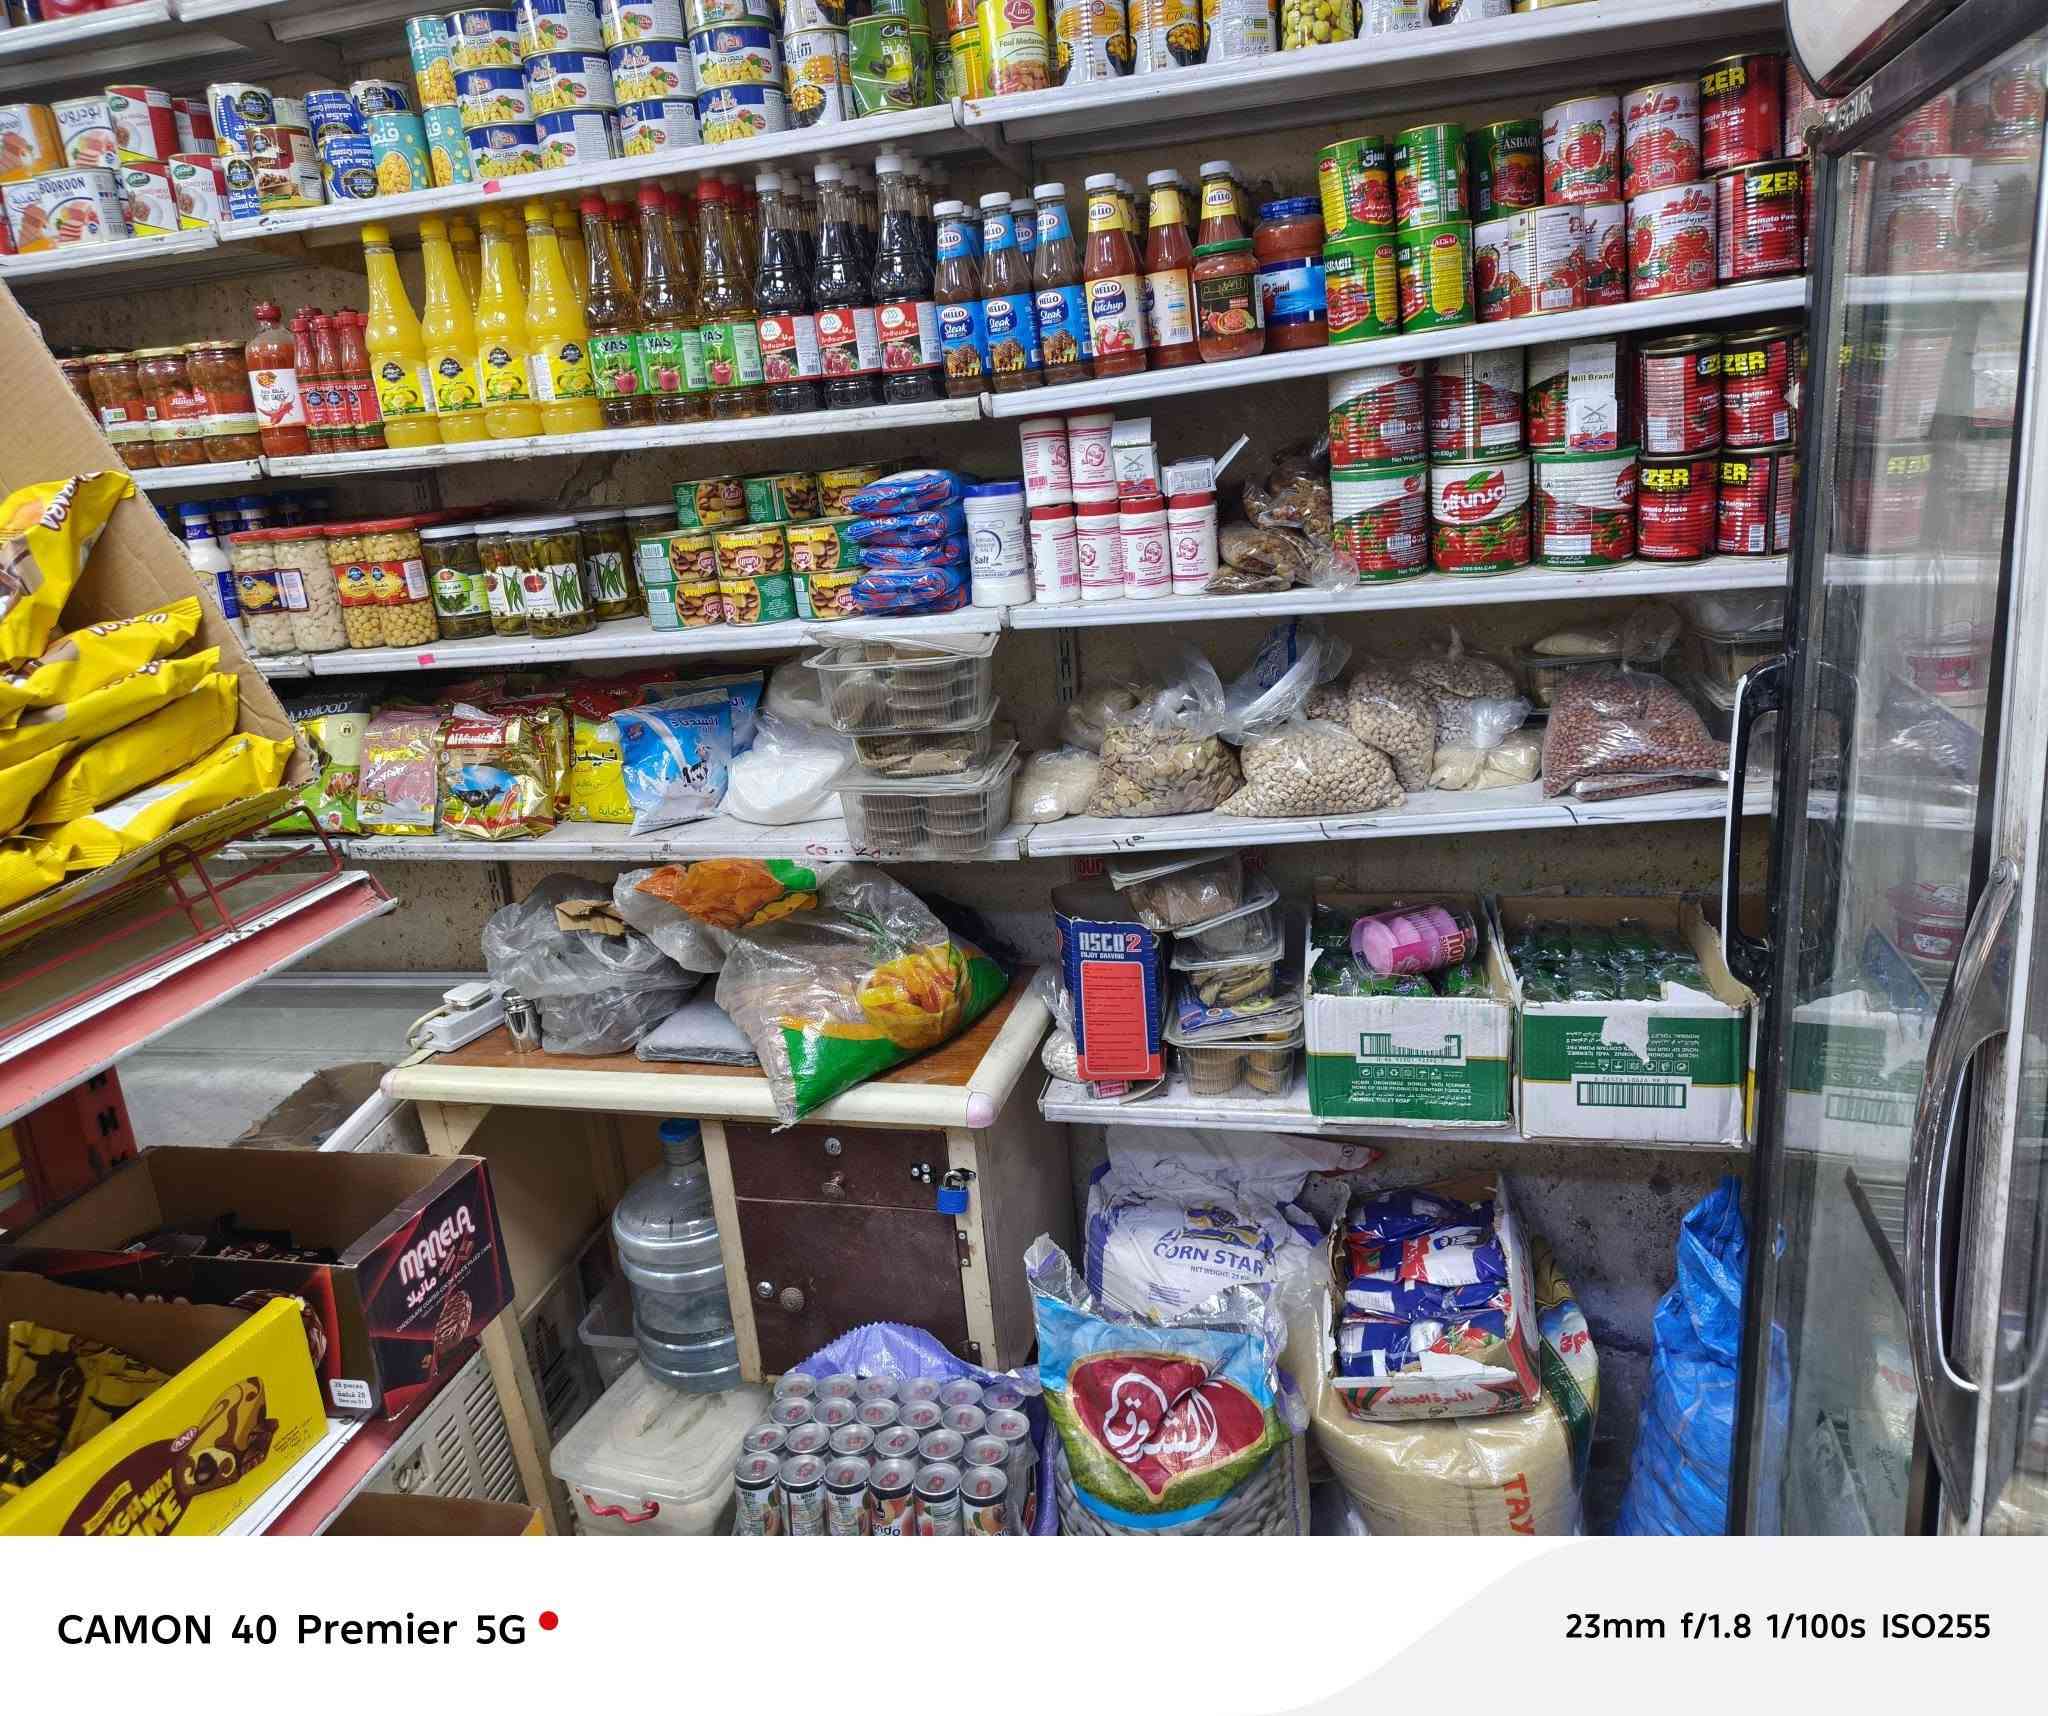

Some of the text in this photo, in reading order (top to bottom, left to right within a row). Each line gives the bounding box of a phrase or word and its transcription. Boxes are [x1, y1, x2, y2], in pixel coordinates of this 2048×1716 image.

[1094, 284, 1118, 296] HELLO
[1039, 295, 1060, 306] HELLO
[943, 310, 965, 318] HELLO
[987, 304, 1008, 313] HELLO
[648, 336, 672, 348] YAS
[703, 330, 723, 342] YAS
[603, 340, 628, 351] YAS
[1647, 468, 1689, 485] ZER
[1126, 933, 1142, 952] 2
[400, 1205, 476, 1285] MANELA
[1153, 1242, 1209, 1262] CORN
